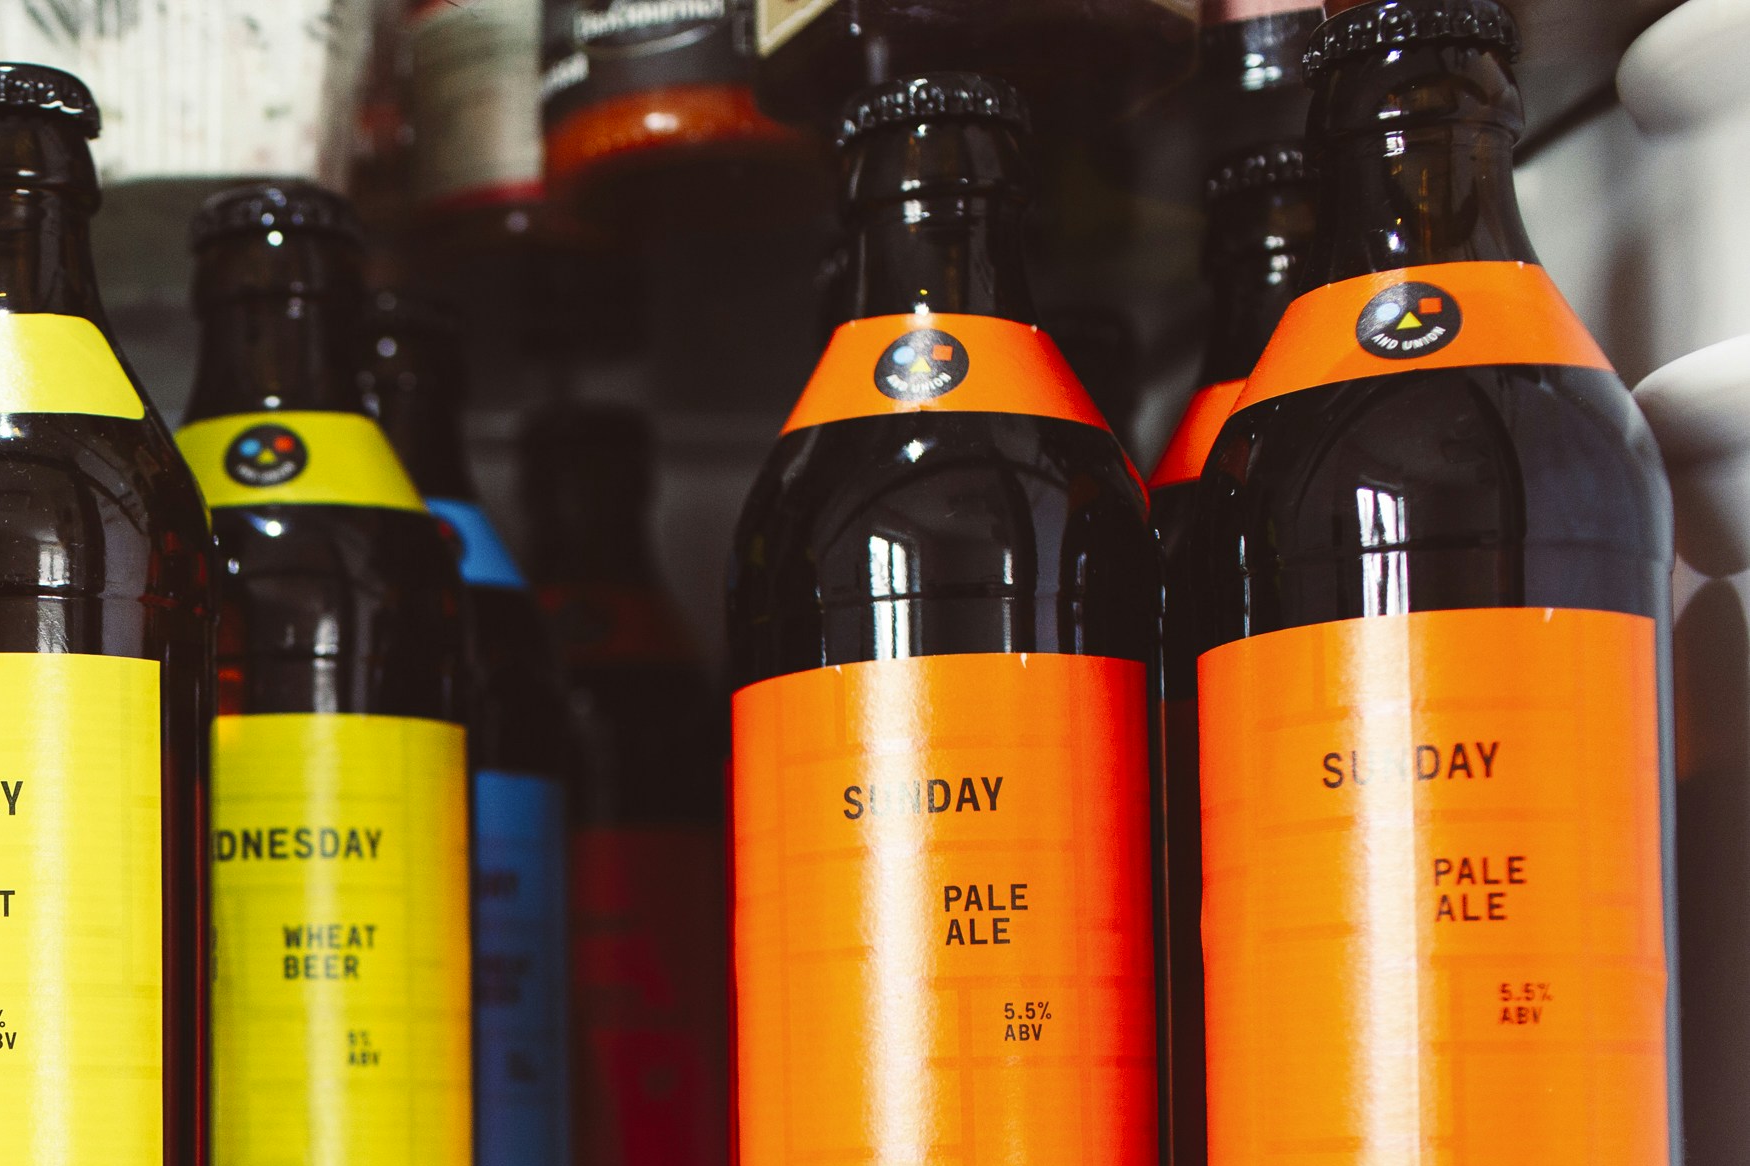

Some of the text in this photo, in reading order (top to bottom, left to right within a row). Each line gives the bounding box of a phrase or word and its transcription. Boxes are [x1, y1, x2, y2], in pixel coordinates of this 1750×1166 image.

[1371, 326, 1446, 351] AND UNION
[886, 372, 951, 394] AND UNION
[843, 776, 1004, 820] SUNDAY
[212, 827, 383, 863] DNESDAY
[1434, 855, 1527, 887] PALE
[944, 883, 1029, 912] PALE
[1435, 892, 1508, 923] ALE
[282, 923, 378, 950] WHEAT
[945, 917, 1011, 946] ALE
[283, 954, 360, 981] BEER
[1499, 982, 1554, 1002] 5.5%
[1004, 1000, 1052, 1020] 5.5%
[1498, 1006, 1543, 1025] ABV
[1004, 1023, 1043, 1041] ABV
